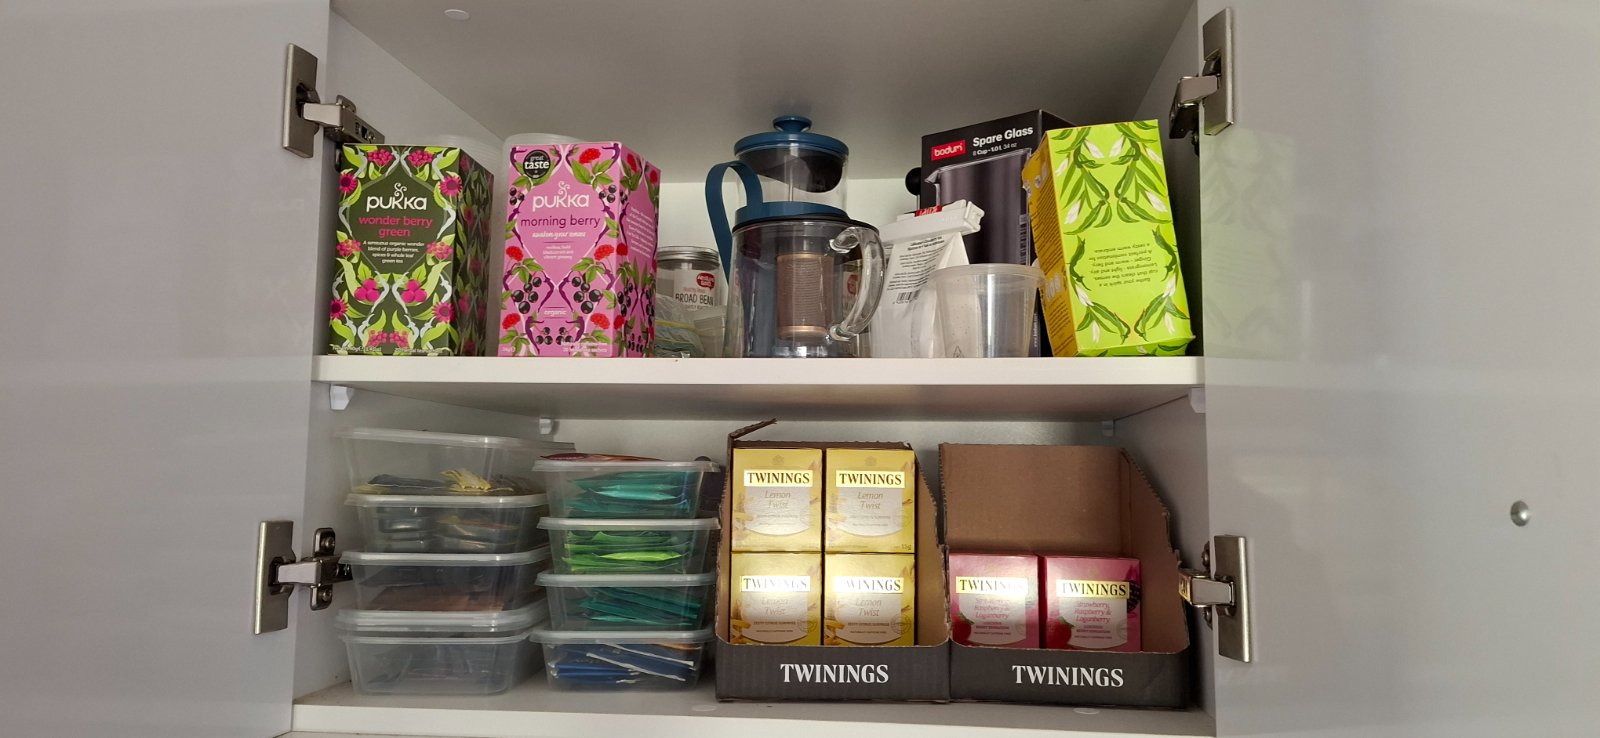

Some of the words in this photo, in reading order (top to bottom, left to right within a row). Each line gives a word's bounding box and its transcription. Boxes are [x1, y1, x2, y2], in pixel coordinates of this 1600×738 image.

[972, 134, 1002, 148] Spare
[1004, 127, 1033, 140] Glass
[934, 144, 962, 157] bodum
[524, 160, 549, 170] taste
[366, 187, 427, 212] pukka
[532, 186, 590, 212] pukka
[359, 216, 400, 224] wonder
[403, 216, 432, 228] berry
[521, 216, 566, 229] morning
[570, 214, 600, 229] berry
[379, 228, 410, 238] green
[747, 472, 810, 484] TWININGS
[839, 473, 902, 485] TWININGS
[764, 491, 791, 499] Lemon
[857, 492, 883, 500] Lemon
[768, 500, 789, 509] Twist
[860, 500, 881, 510] Twist
[743, 578, 807, 590] TWINNGS
[840, 579, 901, 591] WININGS
[960, 579, 1022, 592] TWININ
[1061, 583, 1126, 596] TWININGS
[856, 598, 882, 607] Lemon
[765, 607, 786, 615] Twist
[859, 608, 880, 616] Twist
[780, 663, 889, 684] TWININGS
[1012, 665, 1124, 687] TWININGS
